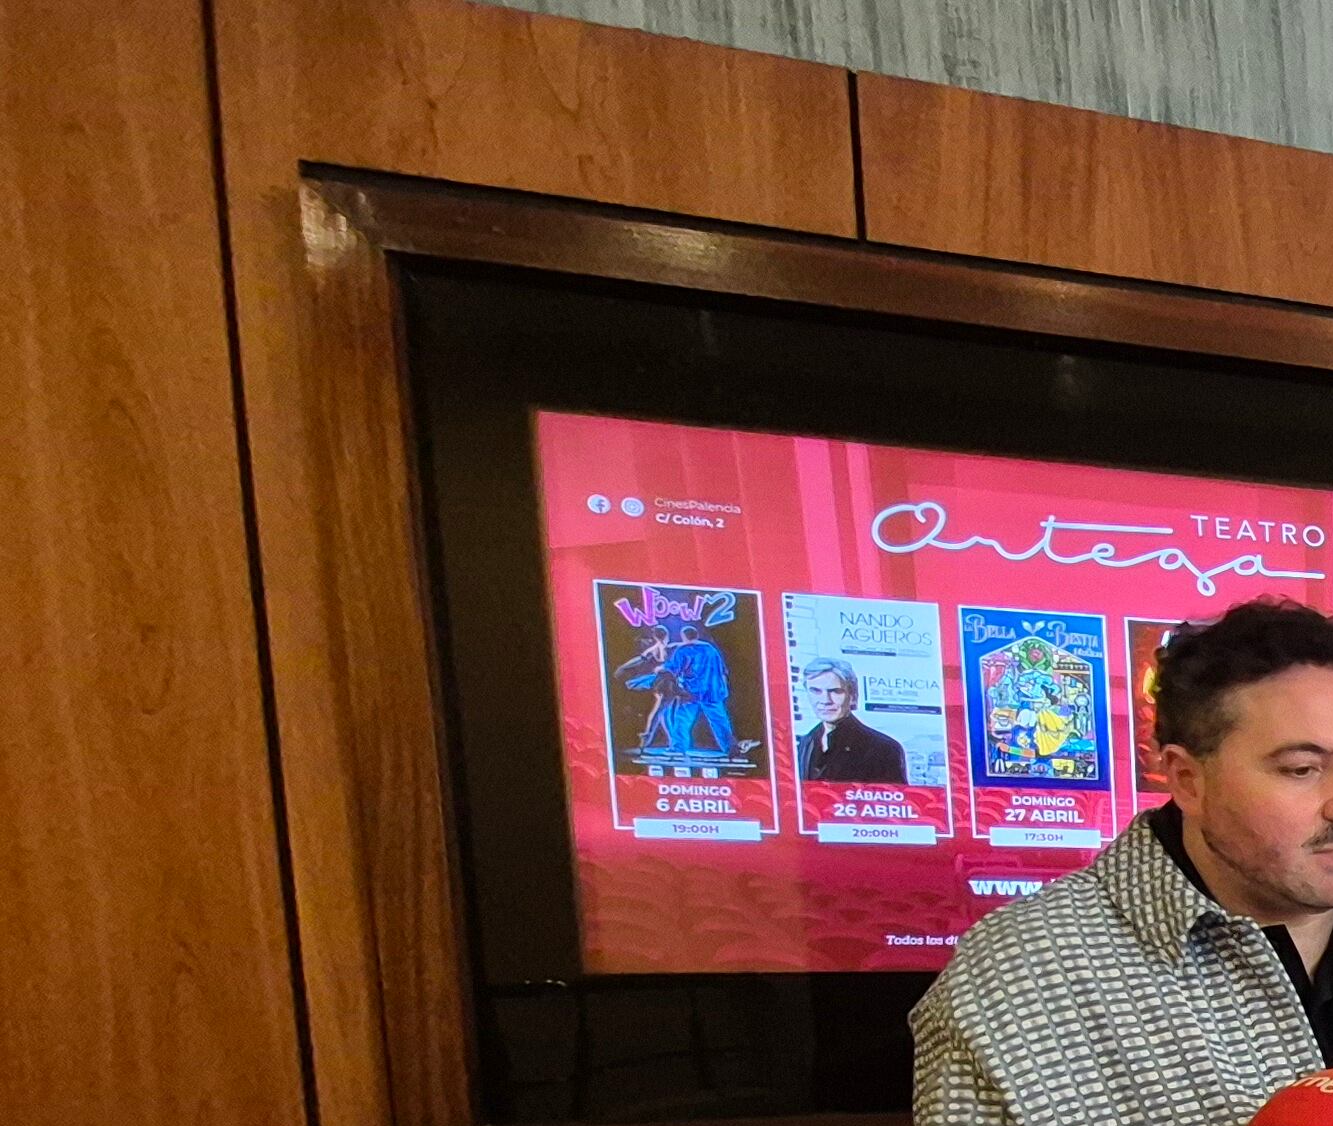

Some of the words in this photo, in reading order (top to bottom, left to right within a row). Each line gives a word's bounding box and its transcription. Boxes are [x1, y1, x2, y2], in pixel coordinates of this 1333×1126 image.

[716, 518, 725, 528] 2
[1190, 514, 1326, 547] TEATRO
[840, 612, 914, 629] NANDO
[841, 627, 933, 646] AGÜEROS
[869, 676, 940, 690] PALENCIA
[658, 784, 732, 798] DOMINGO
[845, 788, 904, 802] SÁBADO
[656, 797, 671, 812] 6
[674, 798, 737, 815] ABRIL
[1012, 794, 1075, 808] DOMINGO
[833, 802, 861, 818] 26
[865, 804, 918, 820] ABRIL
[1005, 808, 1027, 822] 27
[1030, 808, 1084, 824] ABRIL
[672, 823, 719, 834] 19:00H
[852, 828, 899, 839] 20:00H
[1024, 832, 1064, 843] 17:30H
[886, 935, 921, 946] Todos
